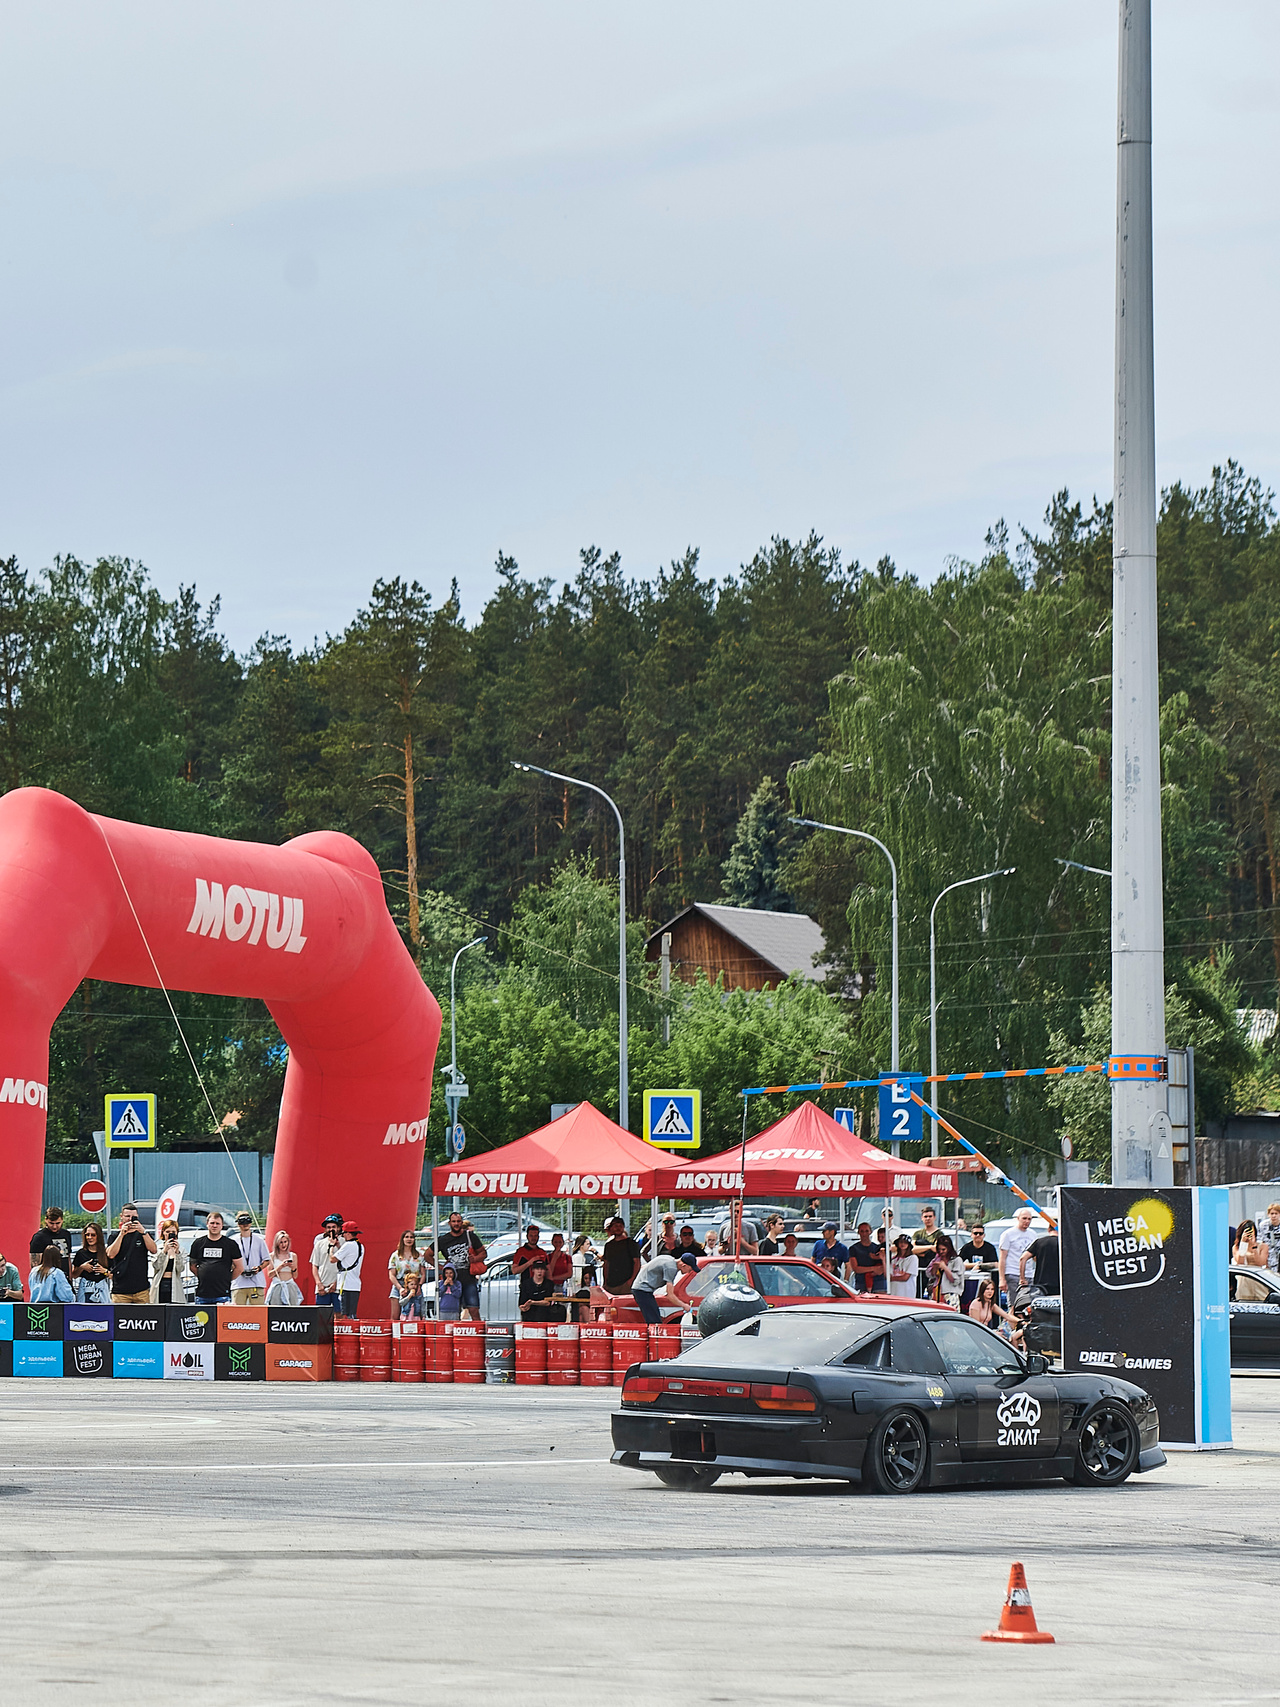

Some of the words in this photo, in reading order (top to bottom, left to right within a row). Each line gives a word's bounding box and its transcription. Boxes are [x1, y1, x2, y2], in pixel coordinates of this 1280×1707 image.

[186, 878, 308, 954] MOTUL
[382, 1116, 428, 1145] MOT
[892, 1109, 910, 1136] 2
[736, 1149, 824, 1161] MOTUL
[445, 1172, 529, 1194] MOTUL
[557, 1174, 643, 1195] MOTUL
[675, 1173, 746, 1190] MOTUL
[795, 1174, 867, 1191] MOTUL
[893, 1174, 916, 1191] MOTUL
[930, 1174, 953, 1191] MOTUL
[1097, 1215, 1149, 1237] MEGA
[1100, 1233, 1164, 1257] URBAN
[1103, 1256, 1148, 1278] FEST
[119, 1319, 158, 1331] ZAKAT
[185, 1322, 205, 1330] URBAN
[271, 1321, 310, 1333] ZAKAT
[78, 1344, 97, 1353] MEGA
[78, 1350, 103, 1361] URBAN
[80, 1359, 97, 1368] FEST
[278, 1360, 313, 1368] GARAGE
[1079, 1351, 1116, 1363] DRIFT
[1124, 1358, 1172, 1370] GAMES
[997, 1428, 1041, 1446] ZAKAT
